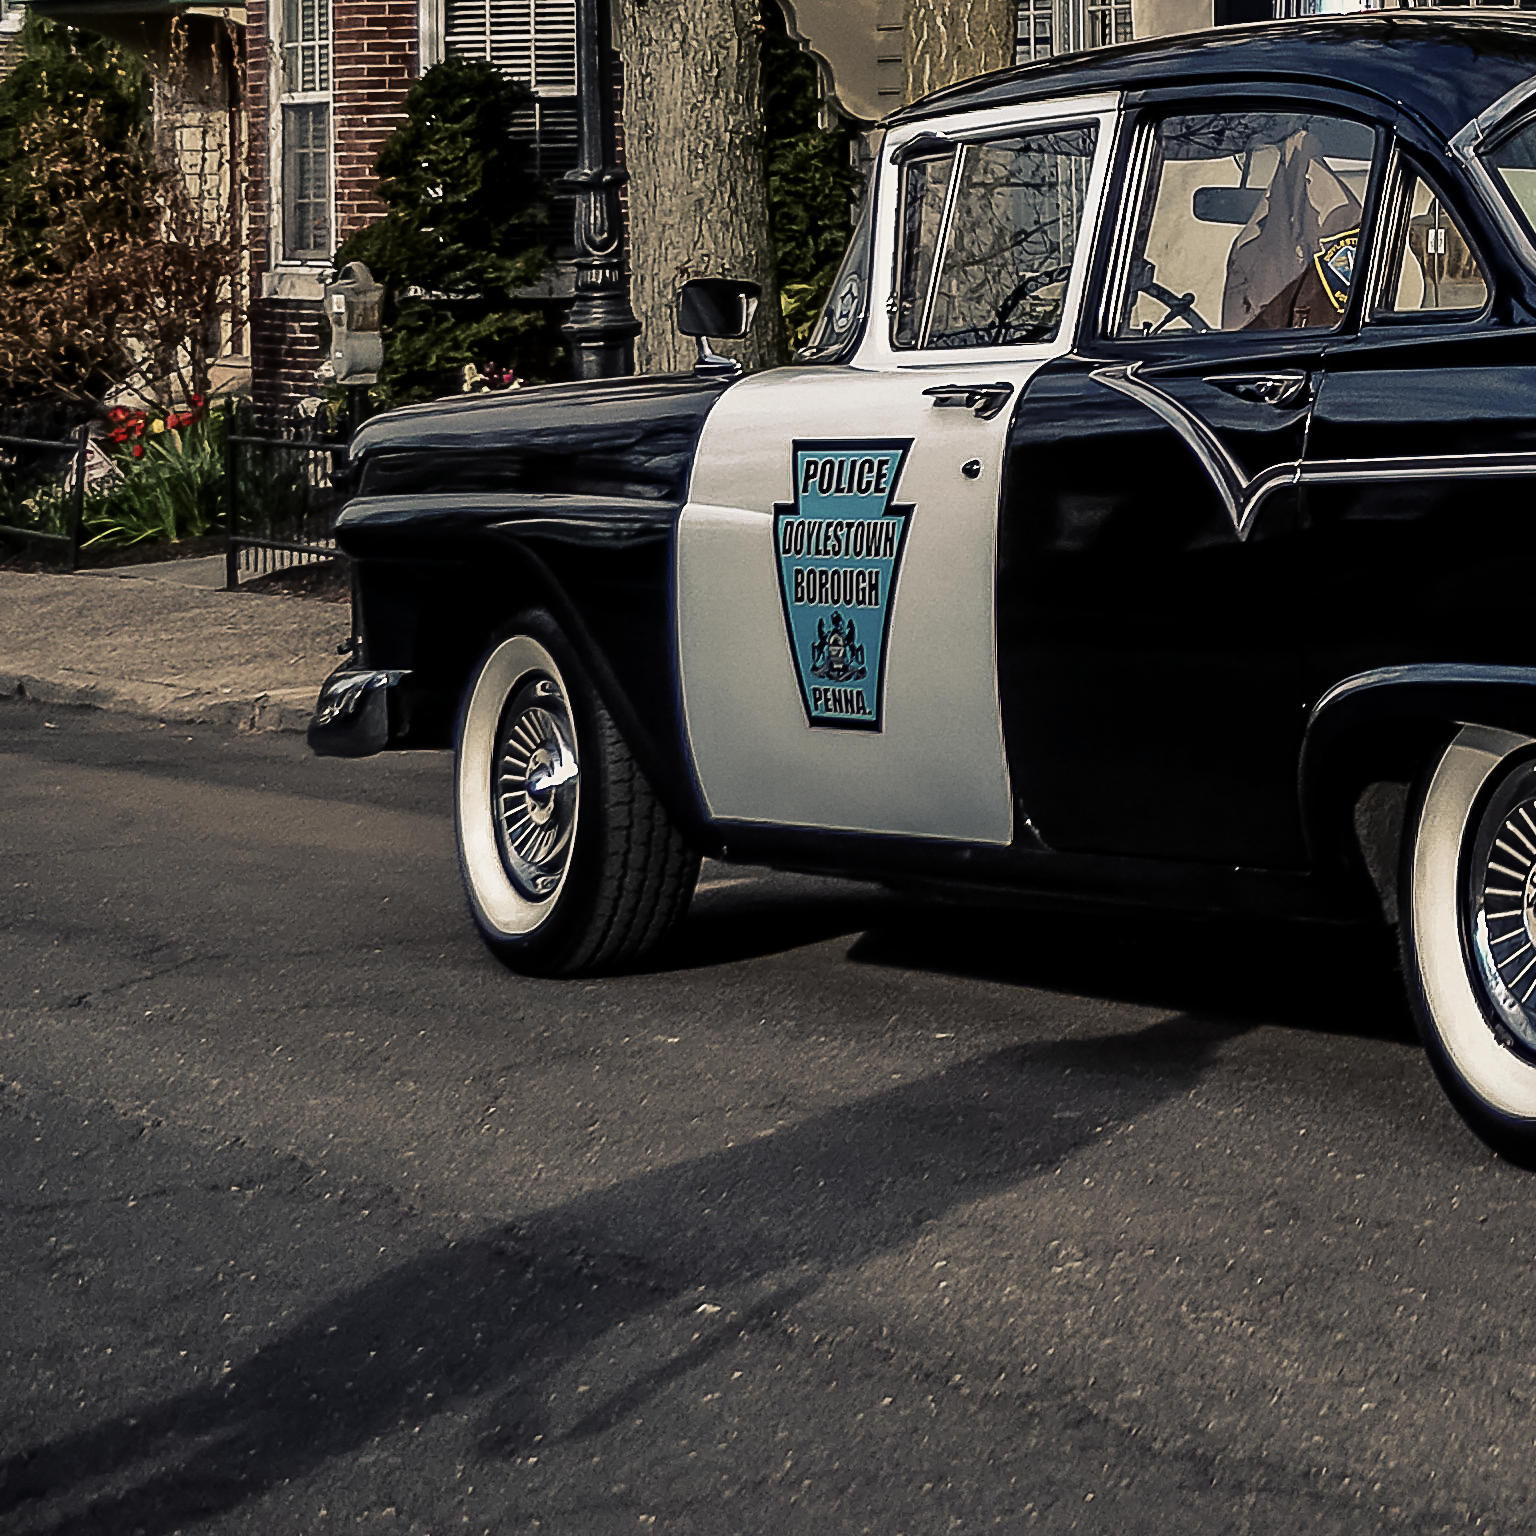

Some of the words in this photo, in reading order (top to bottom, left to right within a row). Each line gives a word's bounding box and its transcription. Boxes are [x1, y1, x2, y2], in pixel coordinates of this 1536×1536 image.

[802, 457, 890, 496] POLICE
[781, 518, 897, 559] DOYLESTOWN
[793, 567, 880, 607] BOROUGH
[811, 685, 872, 715] PENNA.
